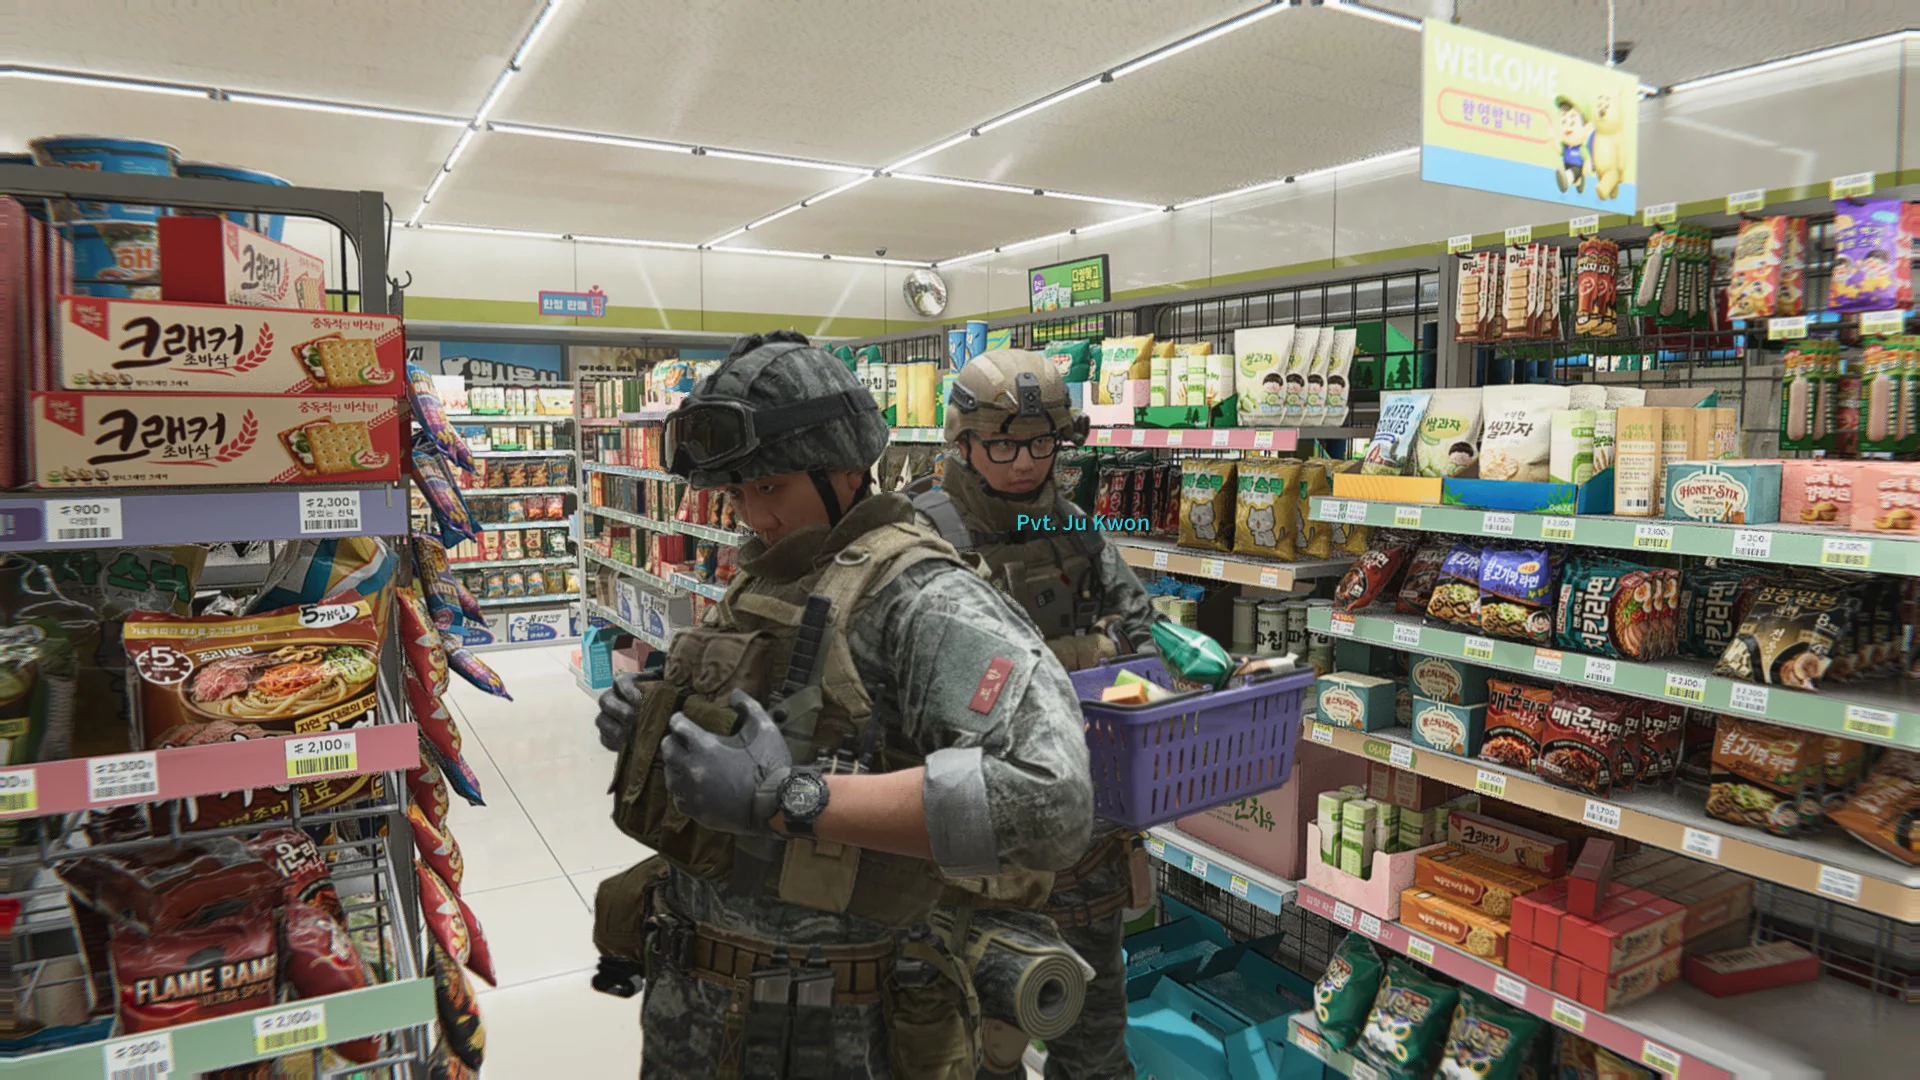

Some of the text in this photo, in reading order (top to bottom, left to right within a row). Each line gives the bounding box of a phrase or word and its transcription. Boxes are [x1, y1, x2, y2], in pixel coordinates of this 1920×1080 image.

[1434, 37, 1560, 96] WELCOME
[1462, 99, 1532, 129] 환영합니다
[311, 317, 350, 330] 중독적인
[111, 316, 244, 370] 크래커
[183, 353, 229, 367] 초바삭
[298, 401, 341, 414] 중독적인
[1383, 404, 1415, 420] WAFER
[87, 409, 226, 465] 크래커
[1425, 417, 1461, 432] 쌀과자
[1487, 420, 1534, 440] 쌀과자
[162, 443, 211, 459] 초바삭
[107, 553, 192, 604] 스틱
[1483, 556, 1519, 586] 불고기맛
[1519, 574, 1540, 589] 라면
[301, 605, 349, 623] 5개입
[1581, 576, 1617, 650] 치킨라면
[151, 645, 176, 667] 5
[298, 718, 320, 733] 자연
[322, 703, 361, 725] 그대로의
[1490, 687, 1548, 721] 매운라면
[1551, 705, 1623, 739] 매운라면
[1232, 797, 1276, 832] 연치유
[1461, 826, 1500, 847] 크래커
[135, 966, 217, 1005] FLAME
